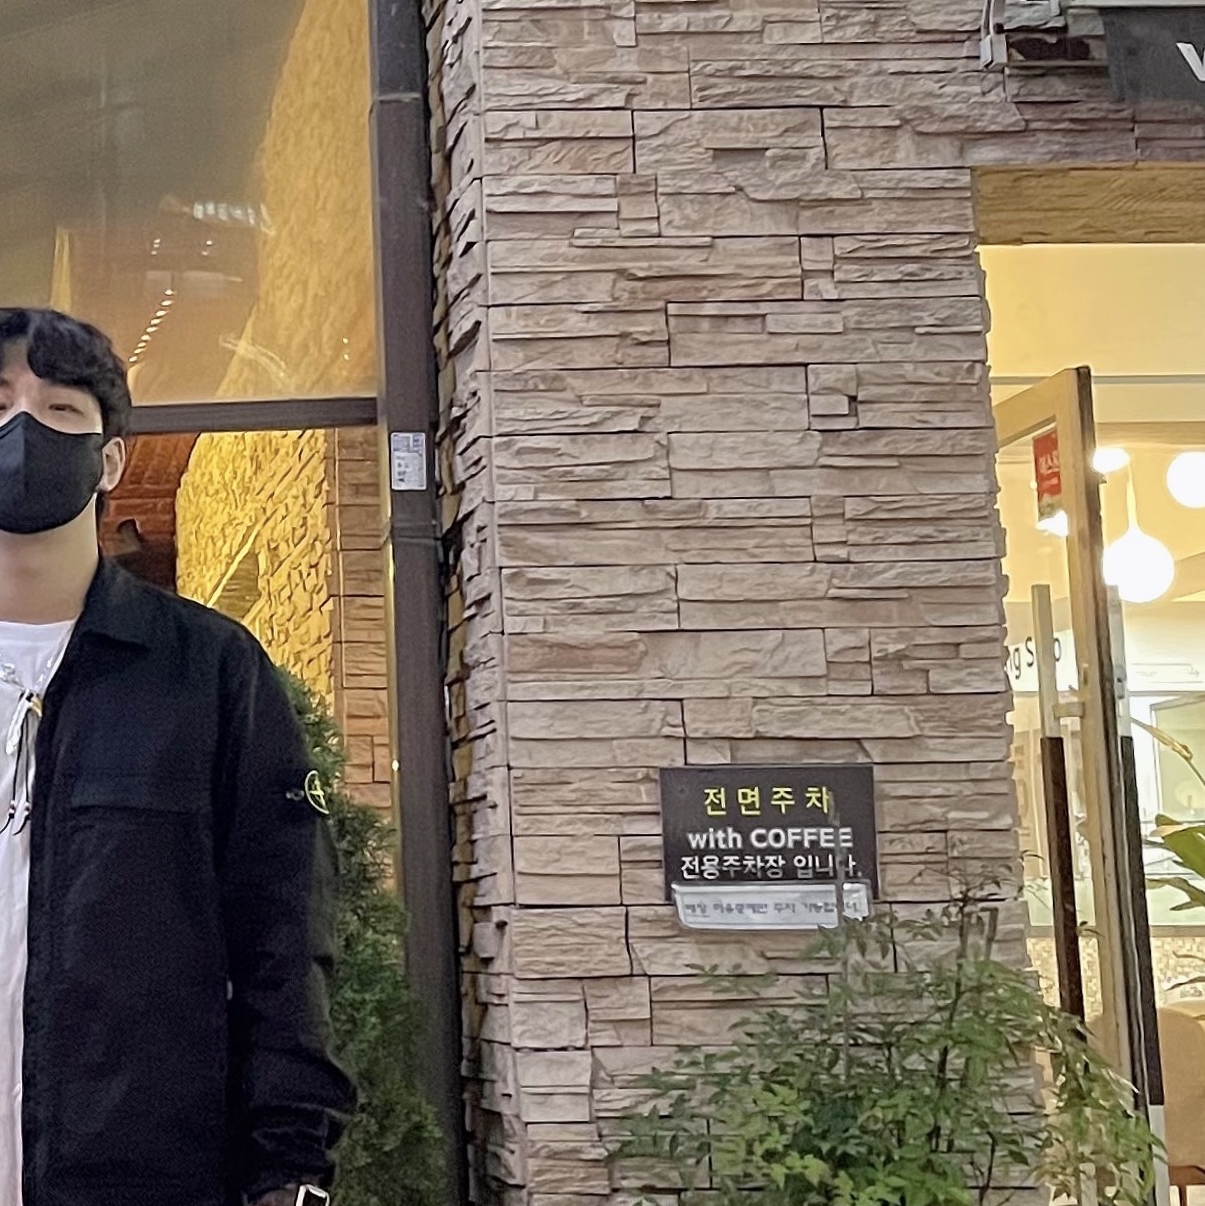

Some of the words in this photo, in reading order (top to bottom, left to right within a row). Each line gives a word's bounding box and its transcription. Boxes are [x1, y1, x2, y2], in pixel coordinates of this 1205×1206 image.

[687, 827, 743, 849] with
[750, 827, 854, 849] COFFEE
[681, 855, 786, 880] 전용주차장
